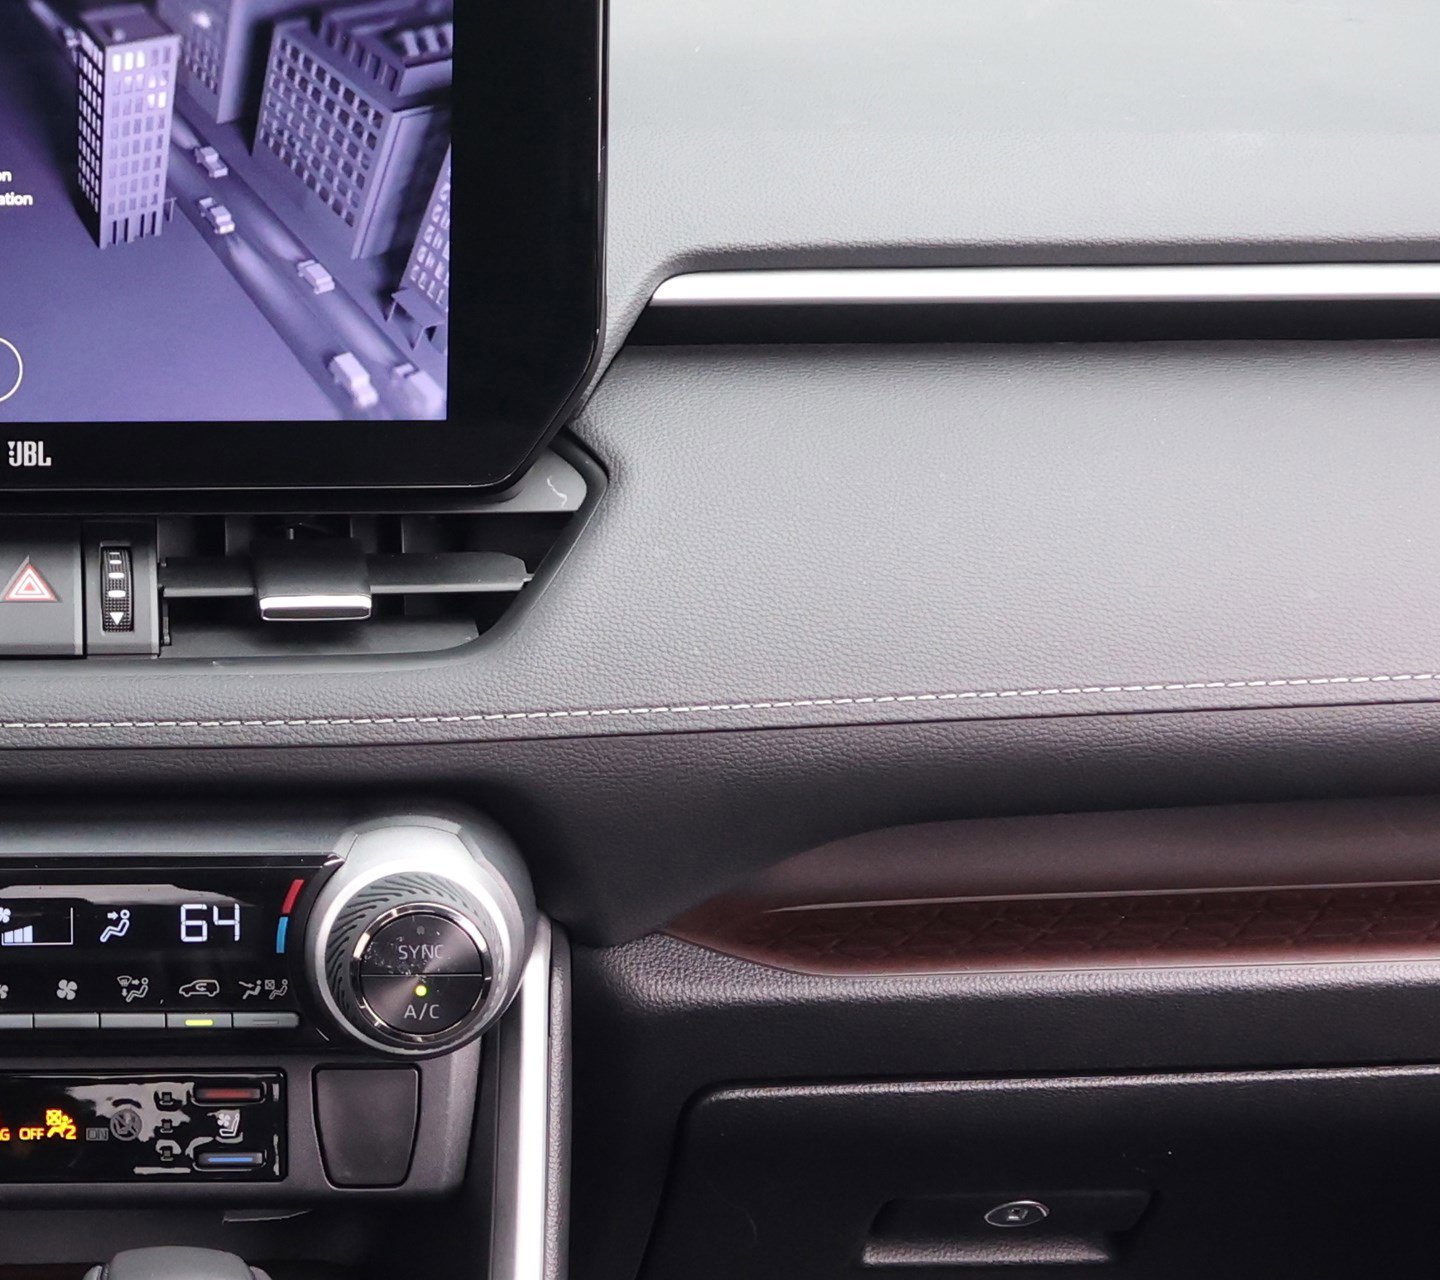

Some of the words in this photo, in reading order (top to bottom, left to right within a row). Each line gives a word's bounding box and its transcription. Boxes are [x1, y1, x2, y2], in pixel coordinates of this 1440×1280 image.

[7, 441, 53, 468] JBL
[179, 903, 242, 944] 64
[397, 944, 445, 962] SYNC
[403, 1002, 441, 1022] A/C
[19, 1128, 45, 1140] OFF
